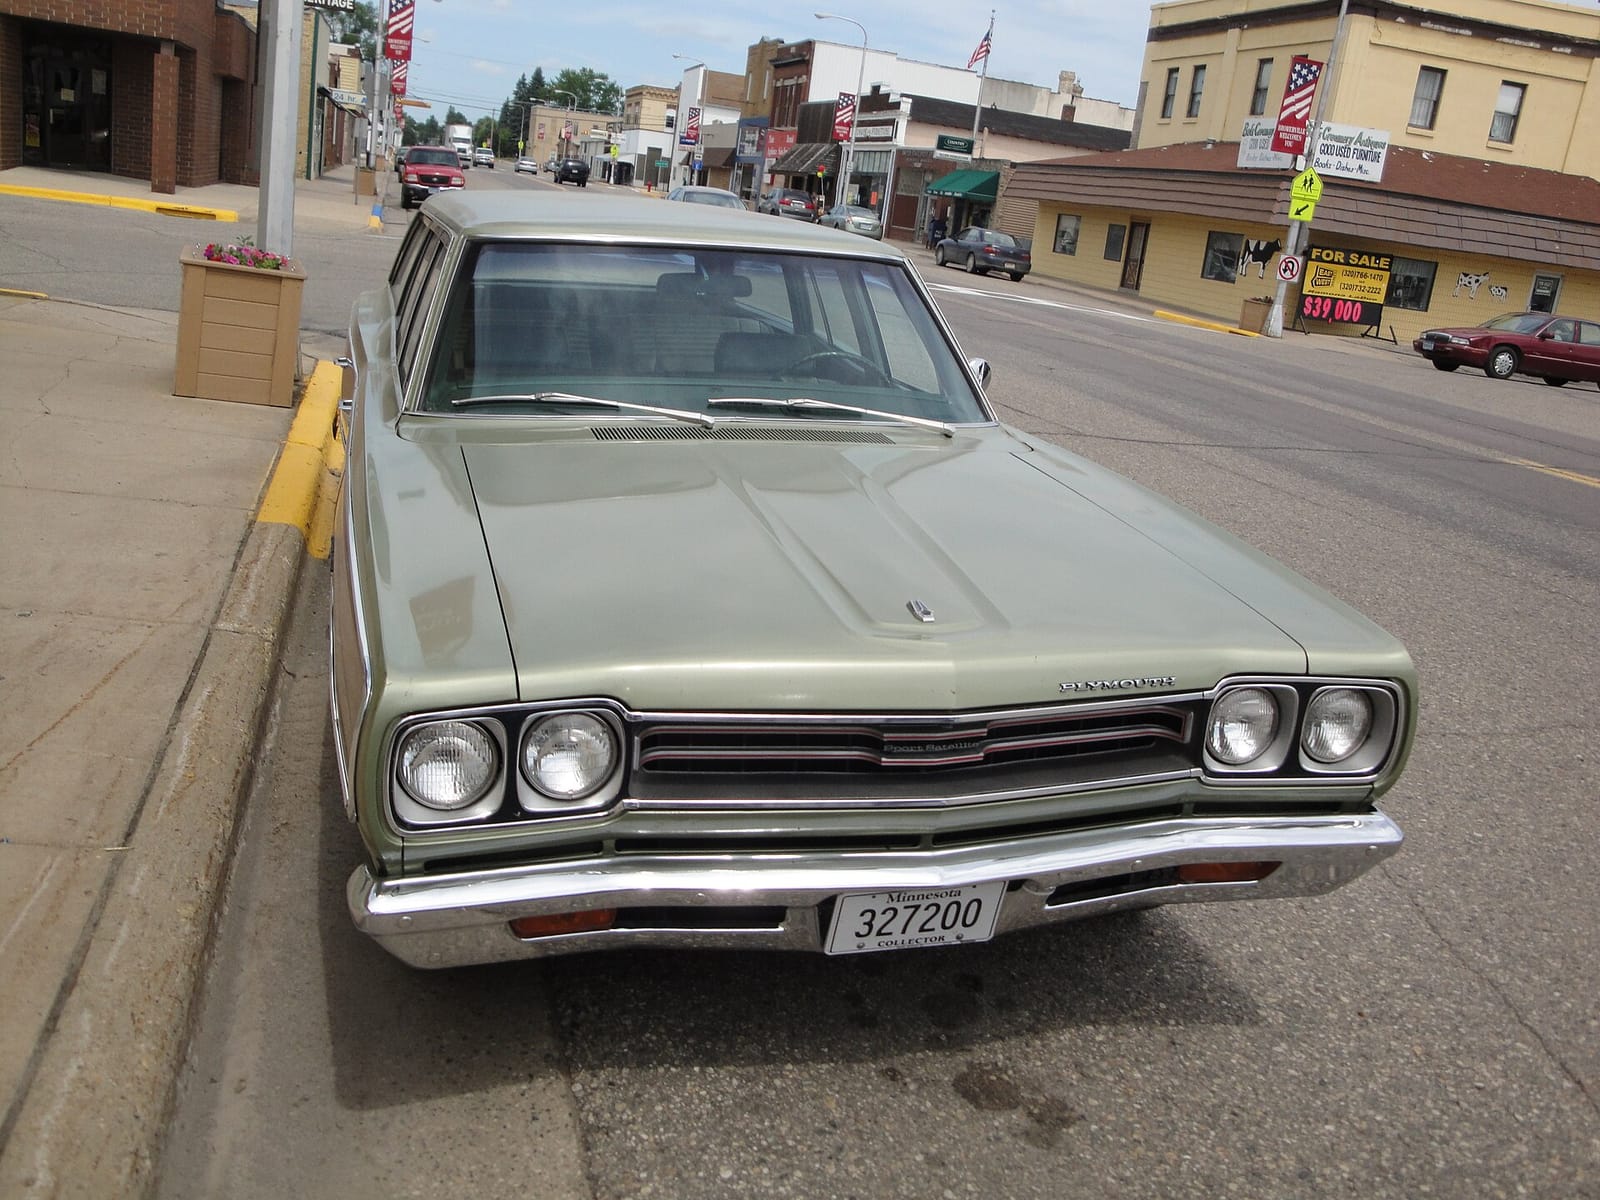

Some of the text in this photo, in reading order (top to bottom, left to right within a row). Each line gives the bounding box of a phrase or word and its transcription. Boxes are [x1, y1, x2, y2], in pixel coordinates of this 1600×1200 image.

[304, 0, 354, 9] ITAGE
[1354, 132, 1387, 150] Antiques
[1319, 143, 1381, 163] GOOD USED FURNITURE
[1314, 157, 1332, 169] Books
[1336, 161, 1354, 172] Dishes
[1311, 247, 1391, 269] FOR SALE
[1303, 296, 1362, 324] $39,000
[1059, 676, 1177, 692] PLYMOUTH
[886, 888, 961, 904] Minnesota
[855, 898, 982, 938] 327200
[877, 935, 946, 948] COLLECTOR
